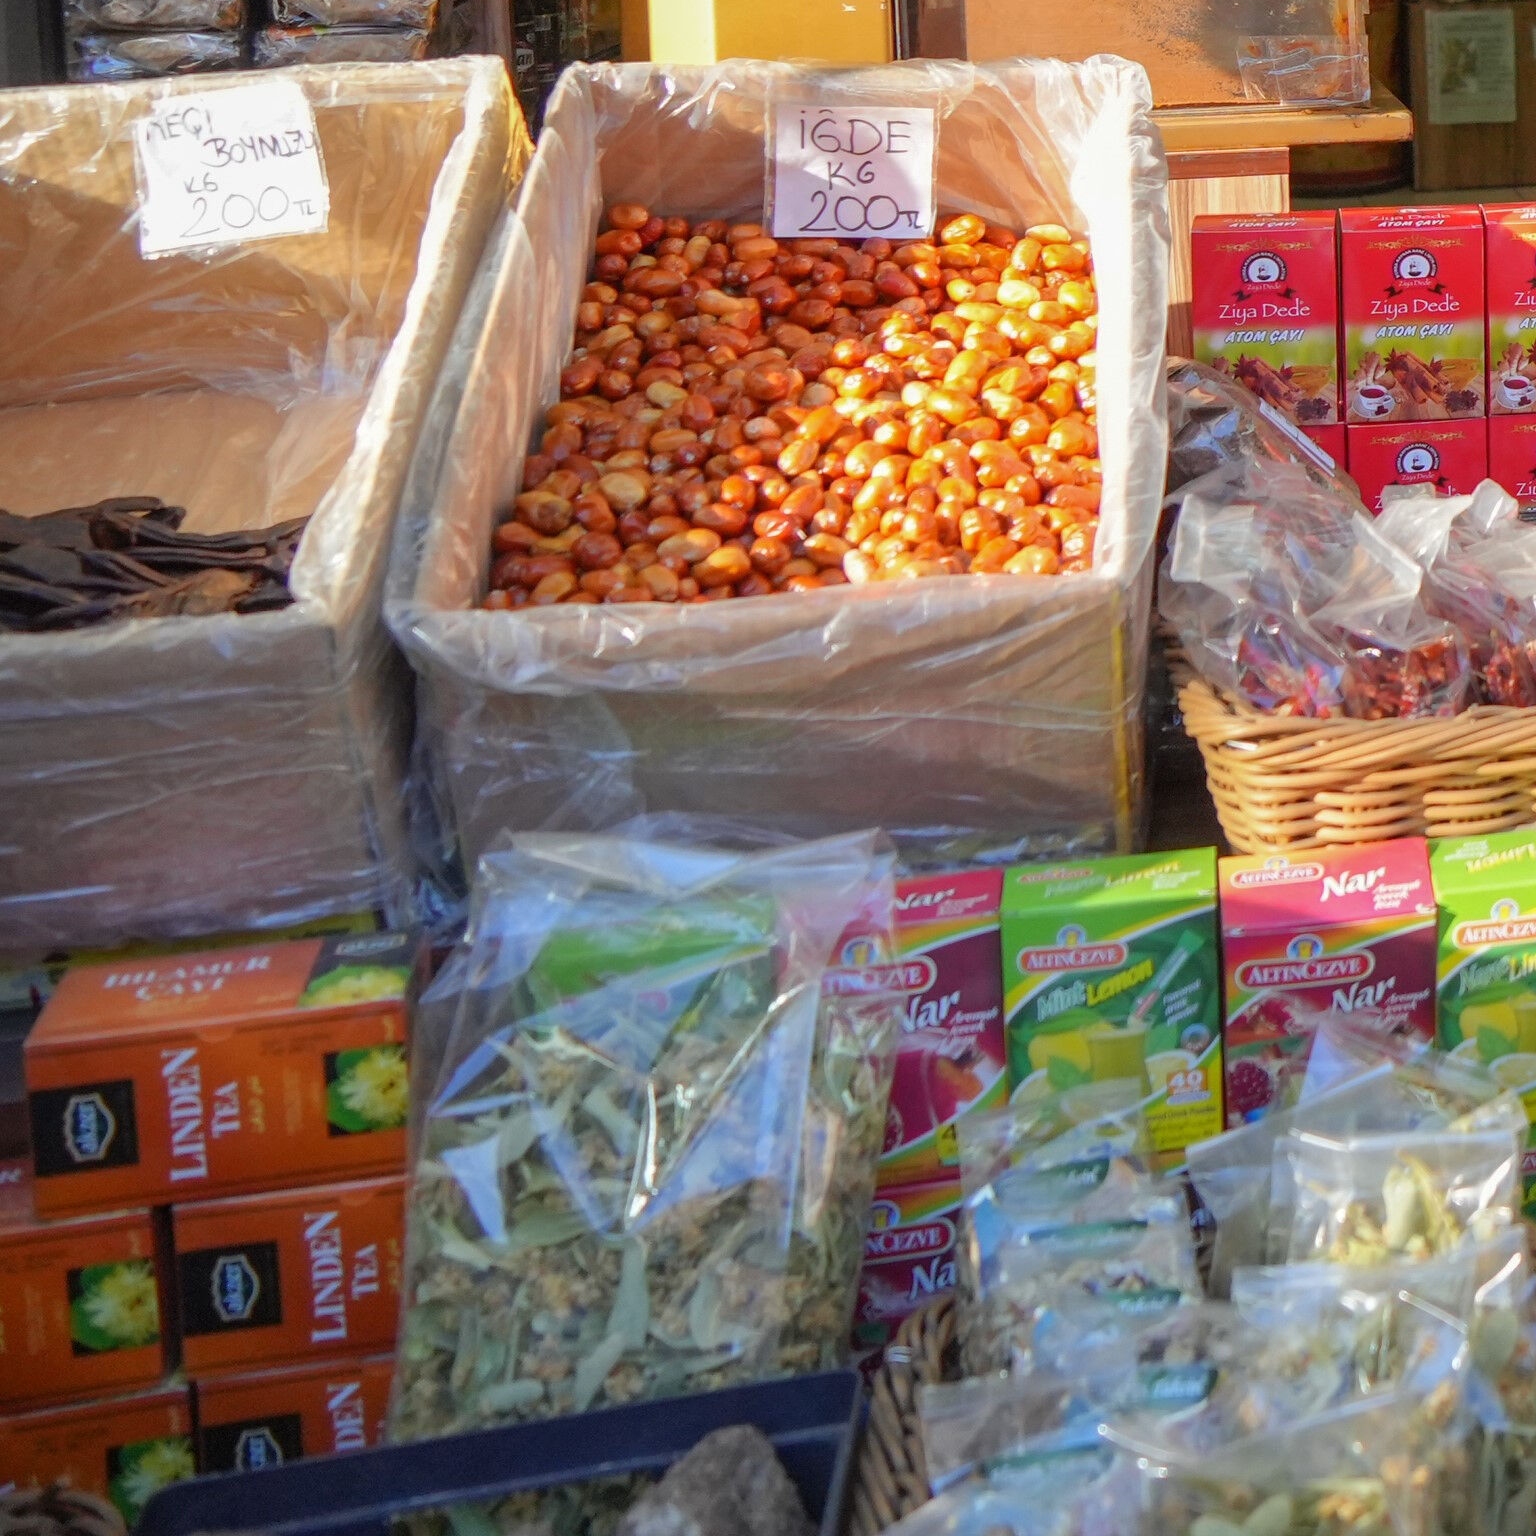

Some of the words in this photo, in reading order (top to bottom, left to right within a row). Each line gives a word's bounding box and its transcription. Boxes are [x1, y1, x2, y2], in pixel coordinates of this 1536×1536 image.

[800, 109, 911, 156] İĞDE
[827, 161, 875, 191] KG
[1219, 303, 1257, 326] Ziya
[1262, 297, 1311, 318] Dede
[1371, 300, 1409, 321] Ziya
[1412, 293, 1460, 314] Dede
[1225, 328, 1268, 344] ATOM
[1270, 328, 1305, 345] ÇAYI
[1376, 324, 1417, 339] ATOM
[1419, 323, 1455, 339] ÇAYI
[1320, 867, 1387, 902] Nar
[1028, 947, 1118, 970] ALTINCEZVE
[1248, 956, 1364, 985] ALTINCEZVE
[1036, 980, 1087, 1024] Mint
[1085, 958, 1154, 1008] Lemon
[1331, 975, 1396, 1014] Nar
[1169, 1070, 1205, 1089] 40
[162, 1047, 208, 1182] LINDEN
[211, 1081, 242, 1138] TEA
[304, 1210, 348, 1343] LINDEN
[351, 1243, 380, 1301] TEA
[911, 1255, 956, 1300] Na
